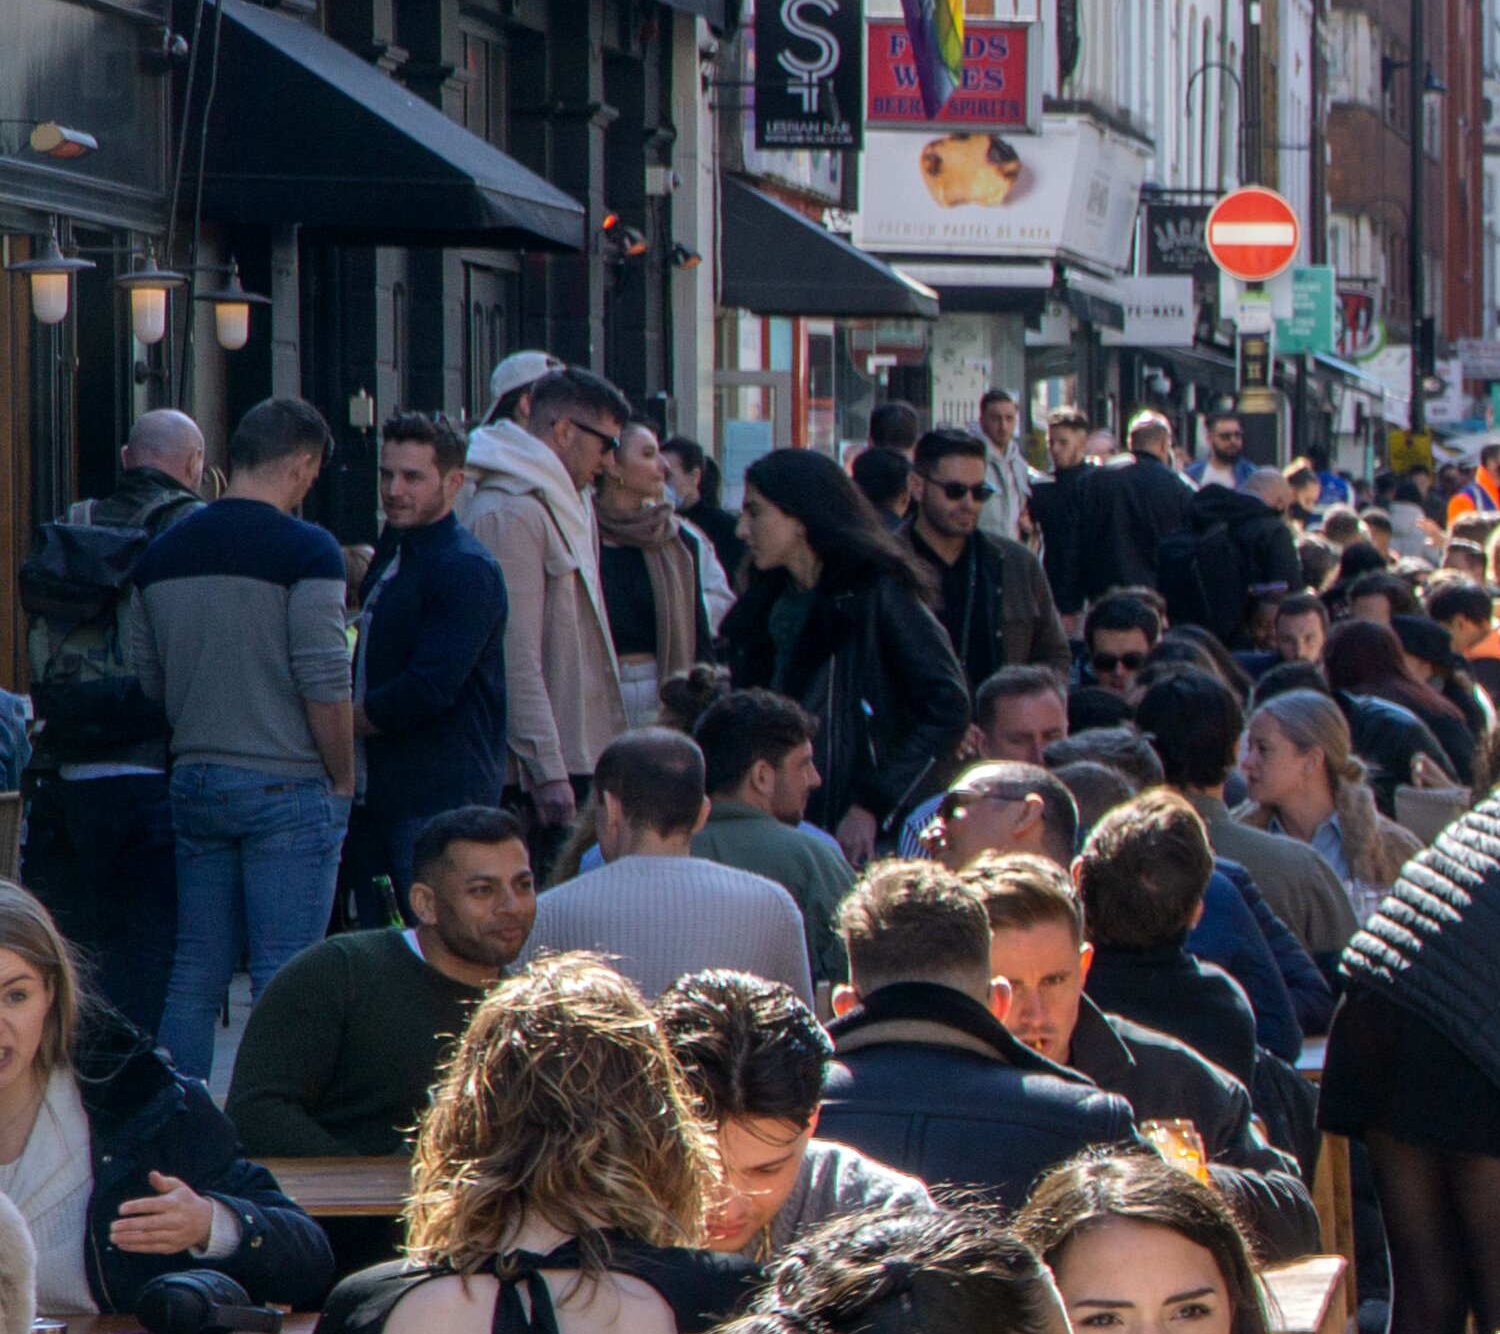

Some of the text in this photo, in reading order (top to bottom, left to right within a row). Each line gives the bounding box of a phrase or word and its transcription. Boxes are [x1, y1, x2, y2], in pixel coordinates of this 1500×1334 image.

[889, 33, 1008, 61] FDS
[893, 63, 1004, 92] WES
[949, 97, 1020, 118] SPIRITS
